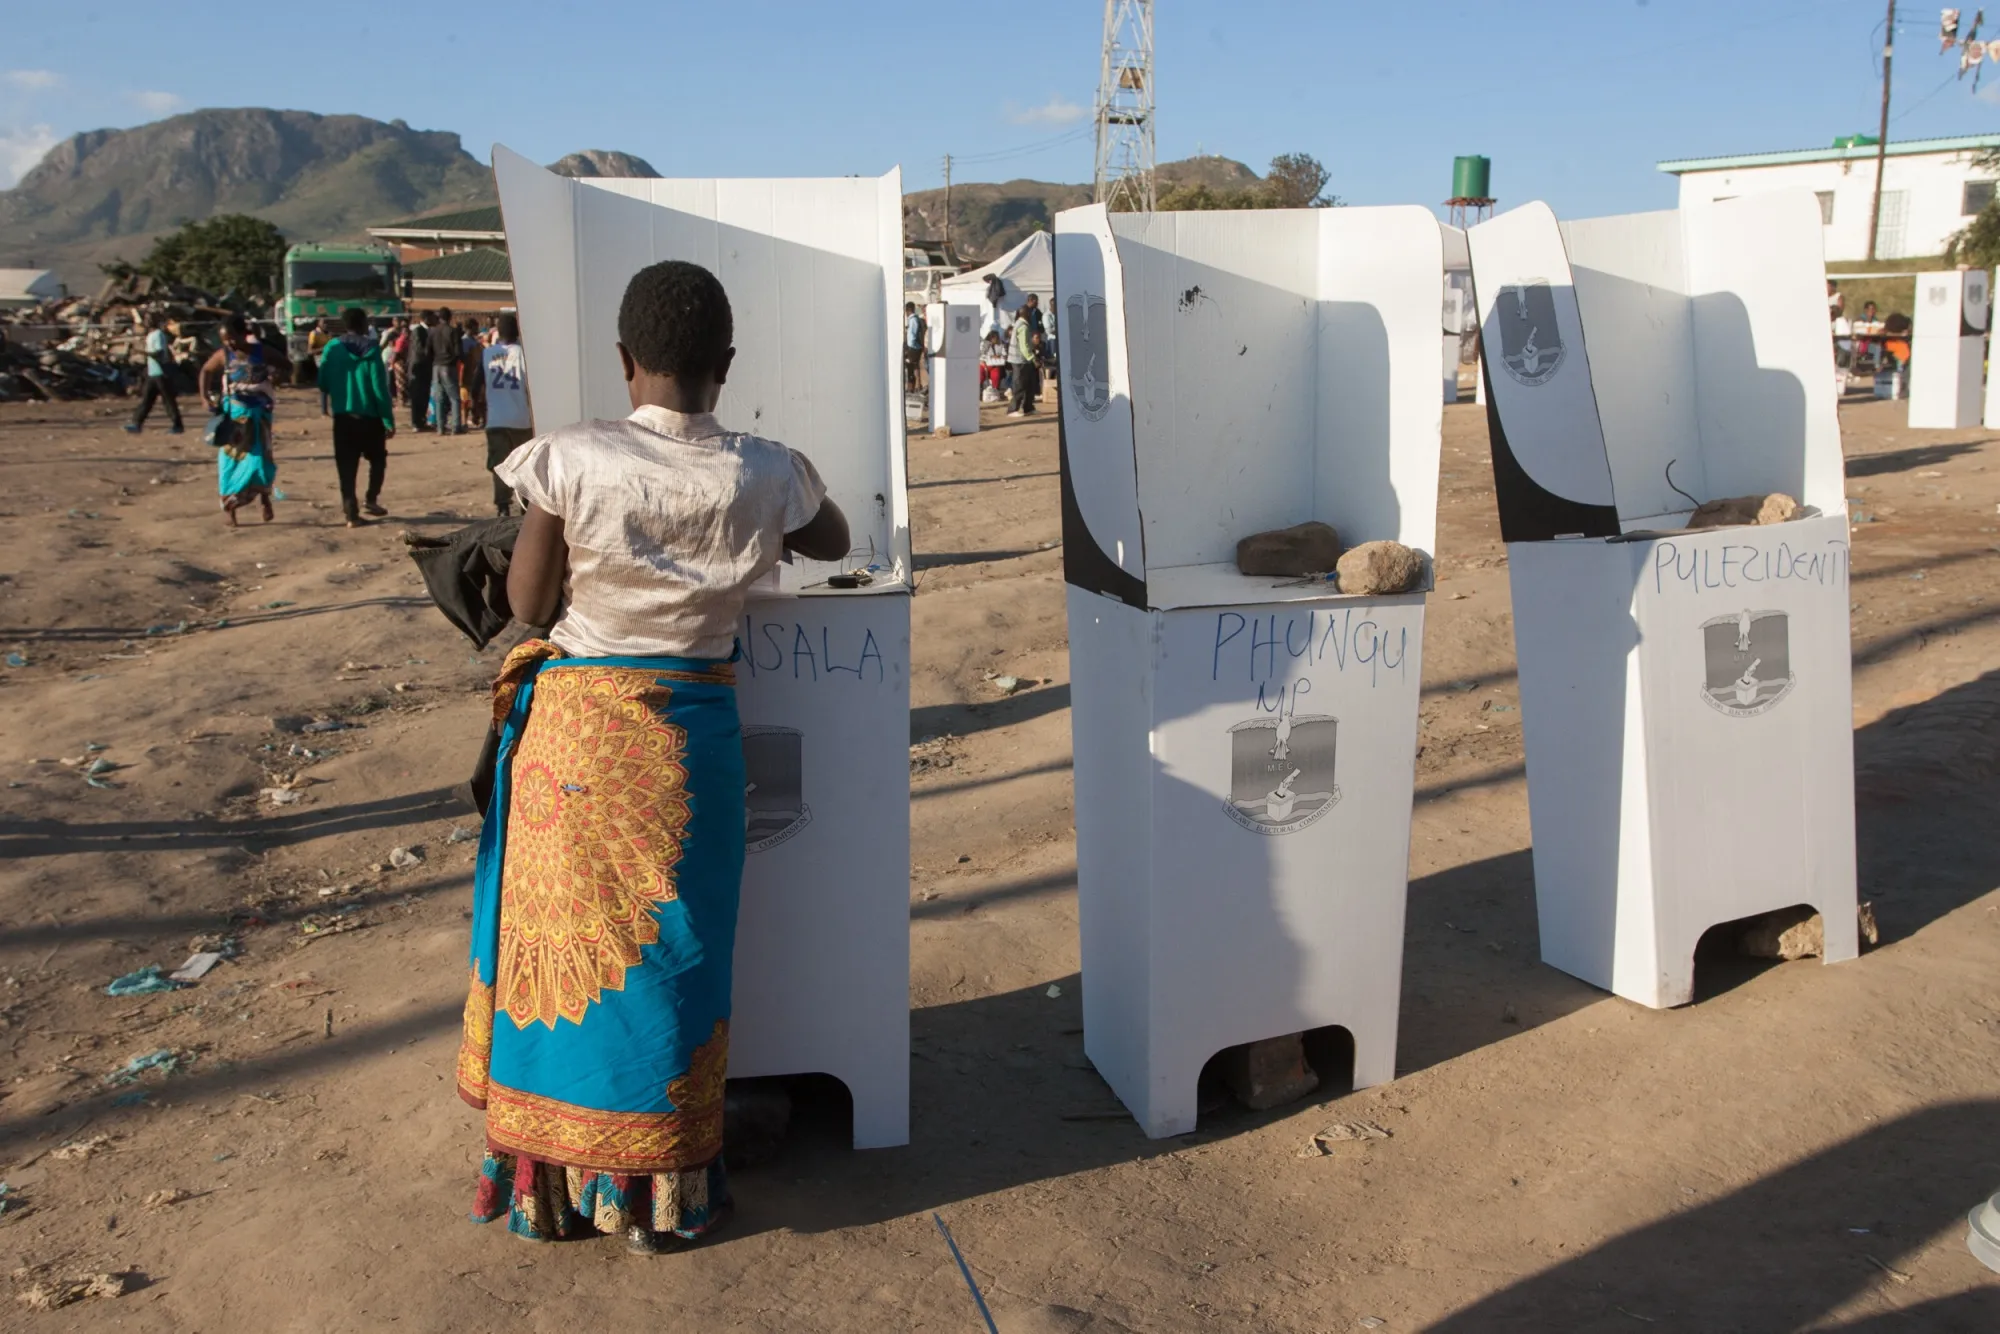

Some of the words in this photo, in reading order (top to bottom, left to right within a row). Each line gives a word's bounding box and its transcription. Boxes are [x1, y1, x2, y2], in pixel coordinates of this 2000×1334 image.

[490, 364, 520, 390] 24
[1212, 609, 1407, 688] PHUNGU
[1255, 677, 1312, 720] MP
[1267, 762, 1294, 772] MEC
[758, 815, 808, 849] COMMISSION
[1226, 806, 1251, 828] MALAWI
[1256, 825, 1296, 834] ELECTORAL
[1299, 796, 1339, 828] COMMISSION
